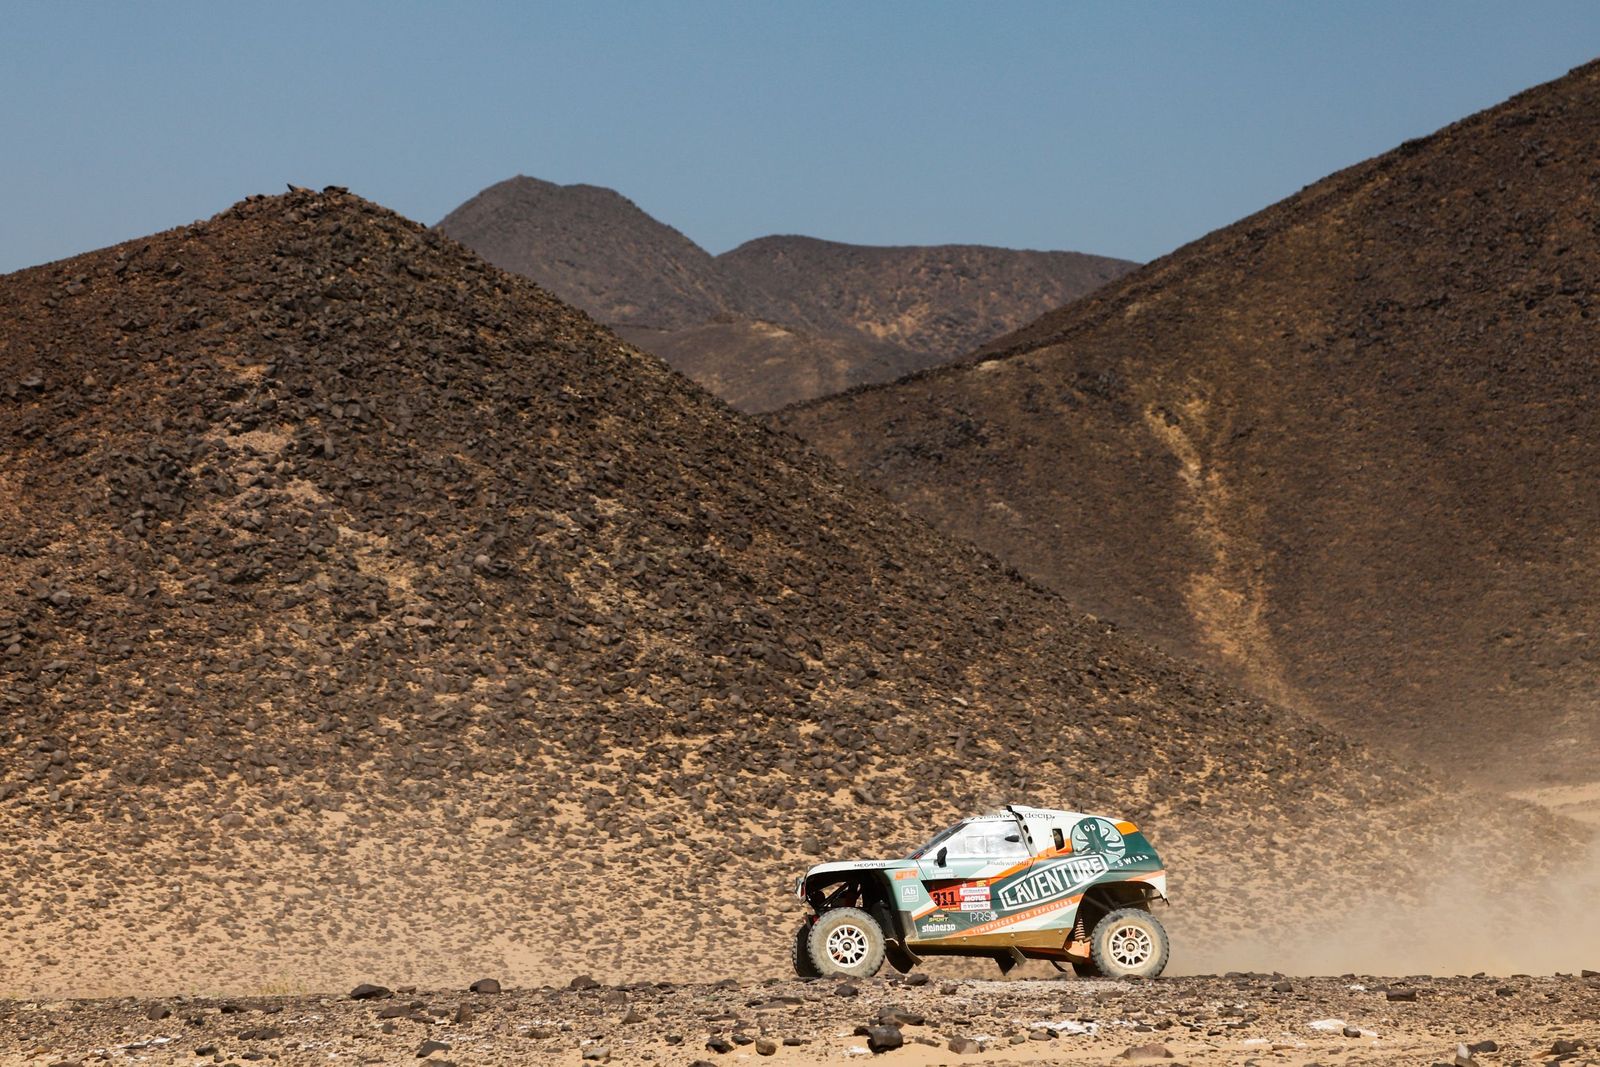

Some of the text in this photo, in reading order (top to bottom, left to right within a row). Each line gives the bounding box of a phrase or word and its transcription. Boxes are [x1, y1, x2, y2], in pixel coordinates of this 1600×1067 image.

[1003, 857, 1103, 906] LAVENTURE
[933, 891, 957, 906] 311
[970, 911, 992, 922] PRS
[972, 900, 1074, 934] TIMEPIECES FOR EXPLORERS
